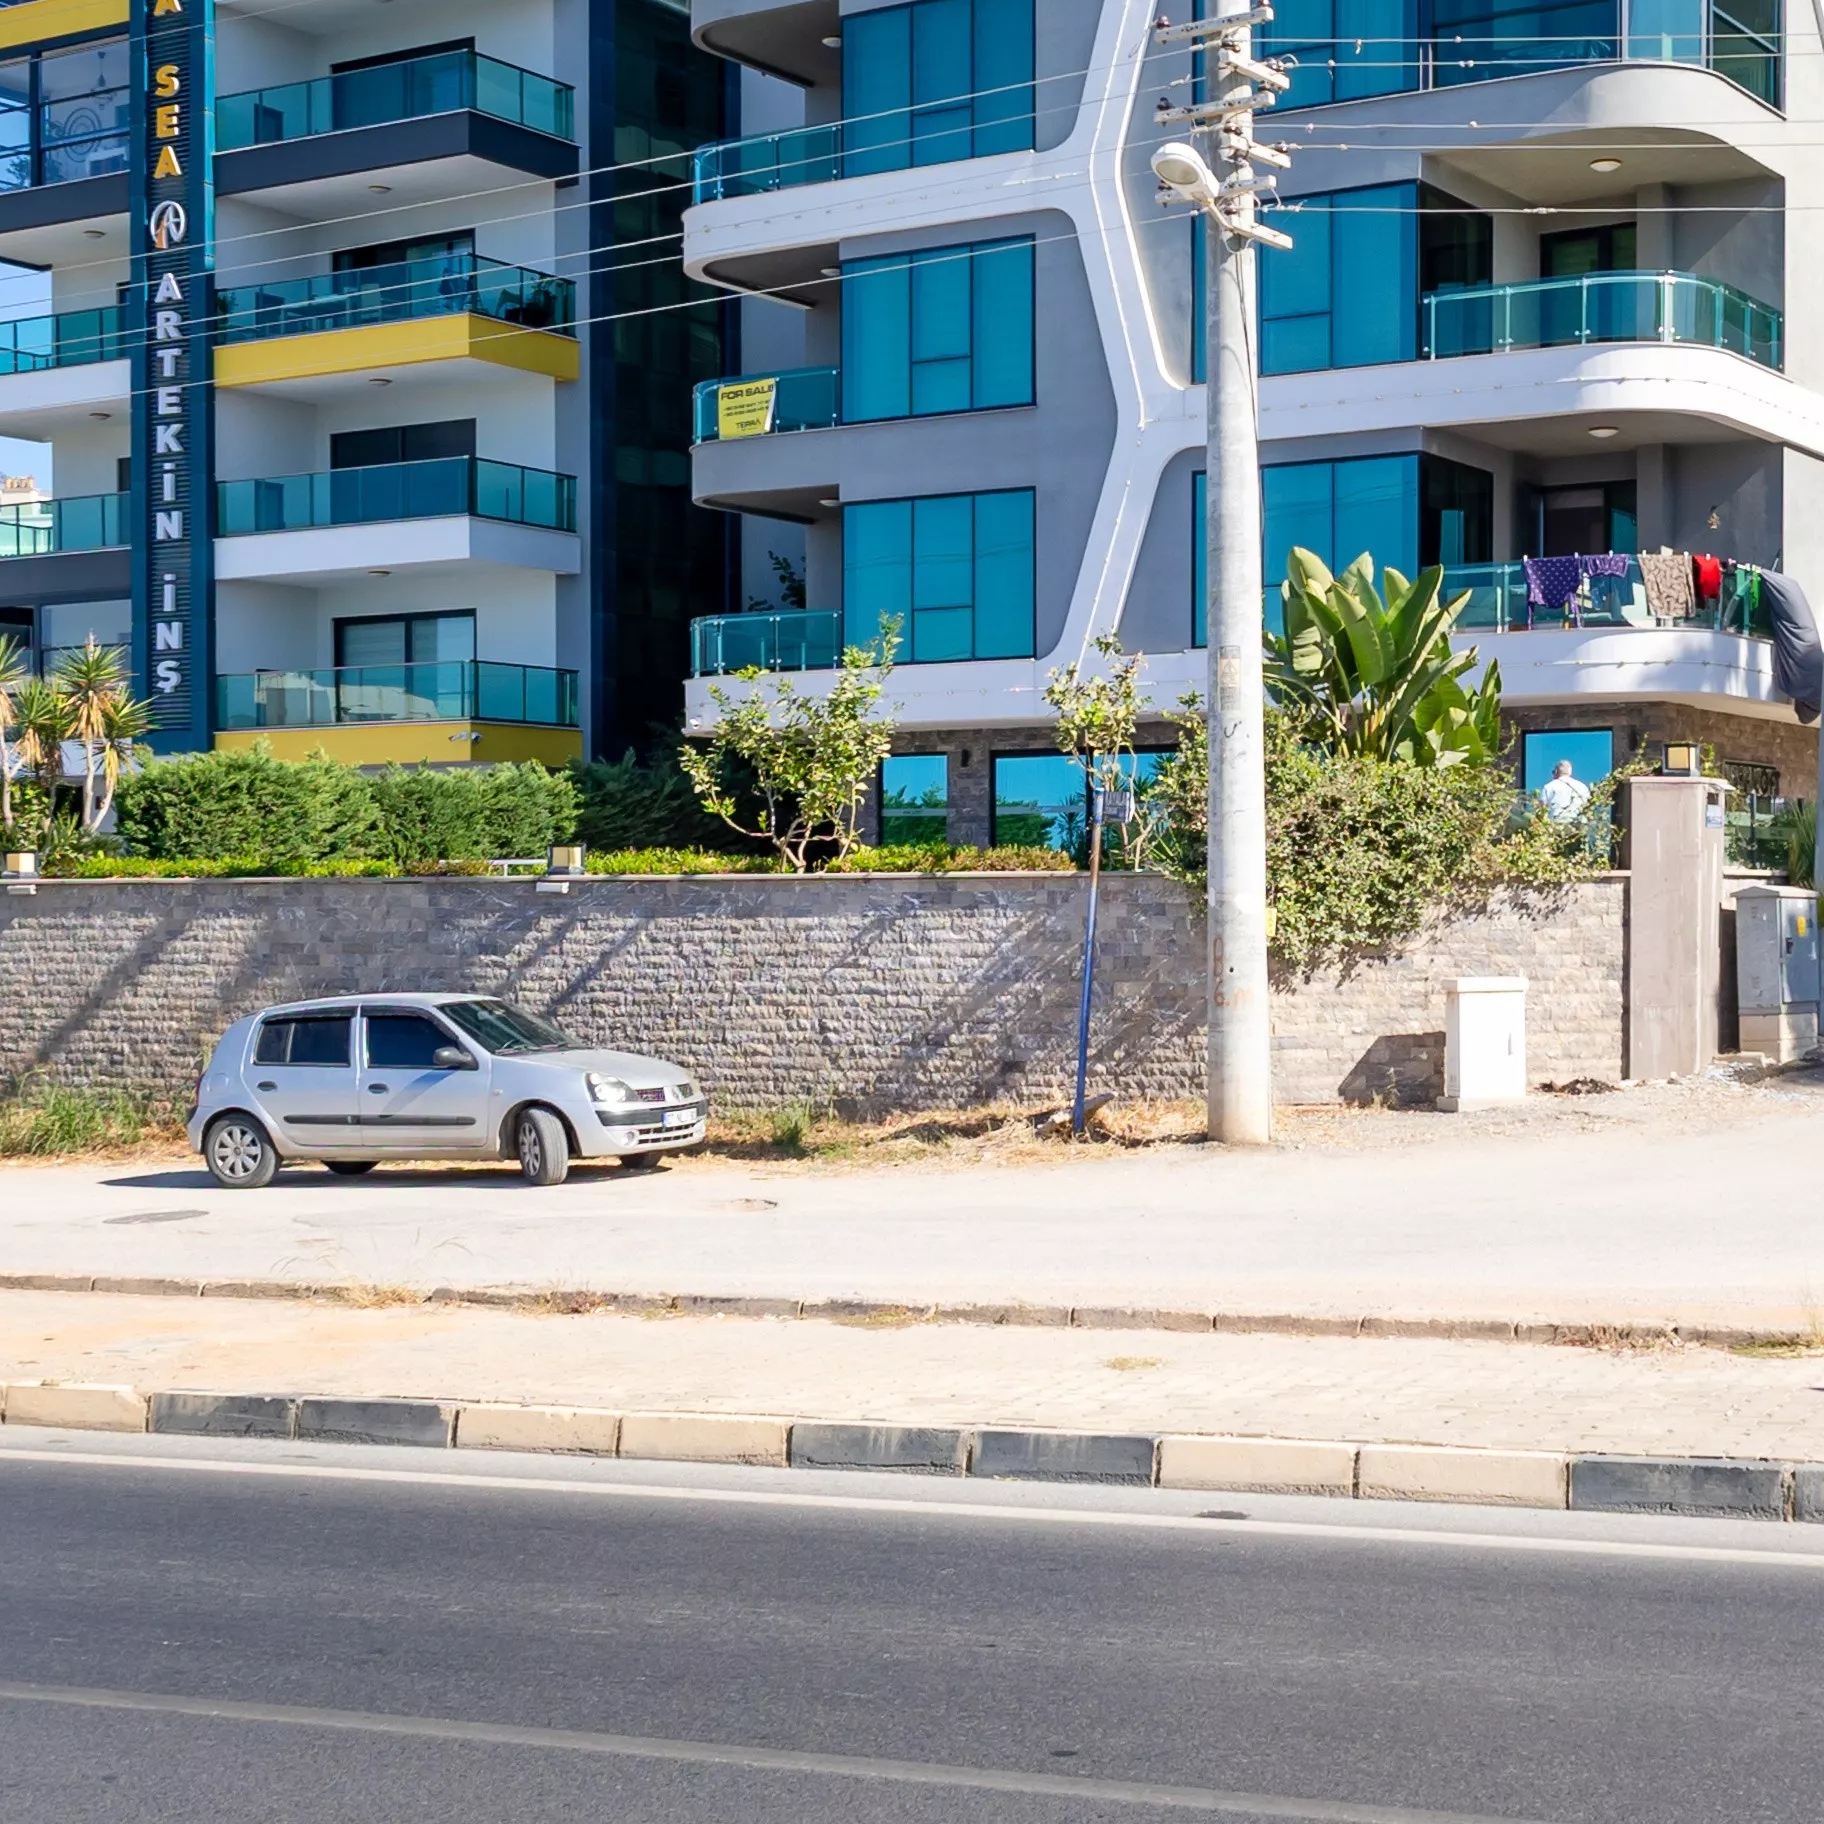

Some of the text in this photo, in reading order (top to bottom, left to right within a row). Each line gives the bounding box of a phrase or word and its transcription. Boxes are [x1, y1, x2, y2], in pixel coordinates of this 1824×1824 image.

[154, 65, 182, 179] SEA
[154, 272, 184, 540] ARTEKİN
[721, 389, 744, 400] FOR
